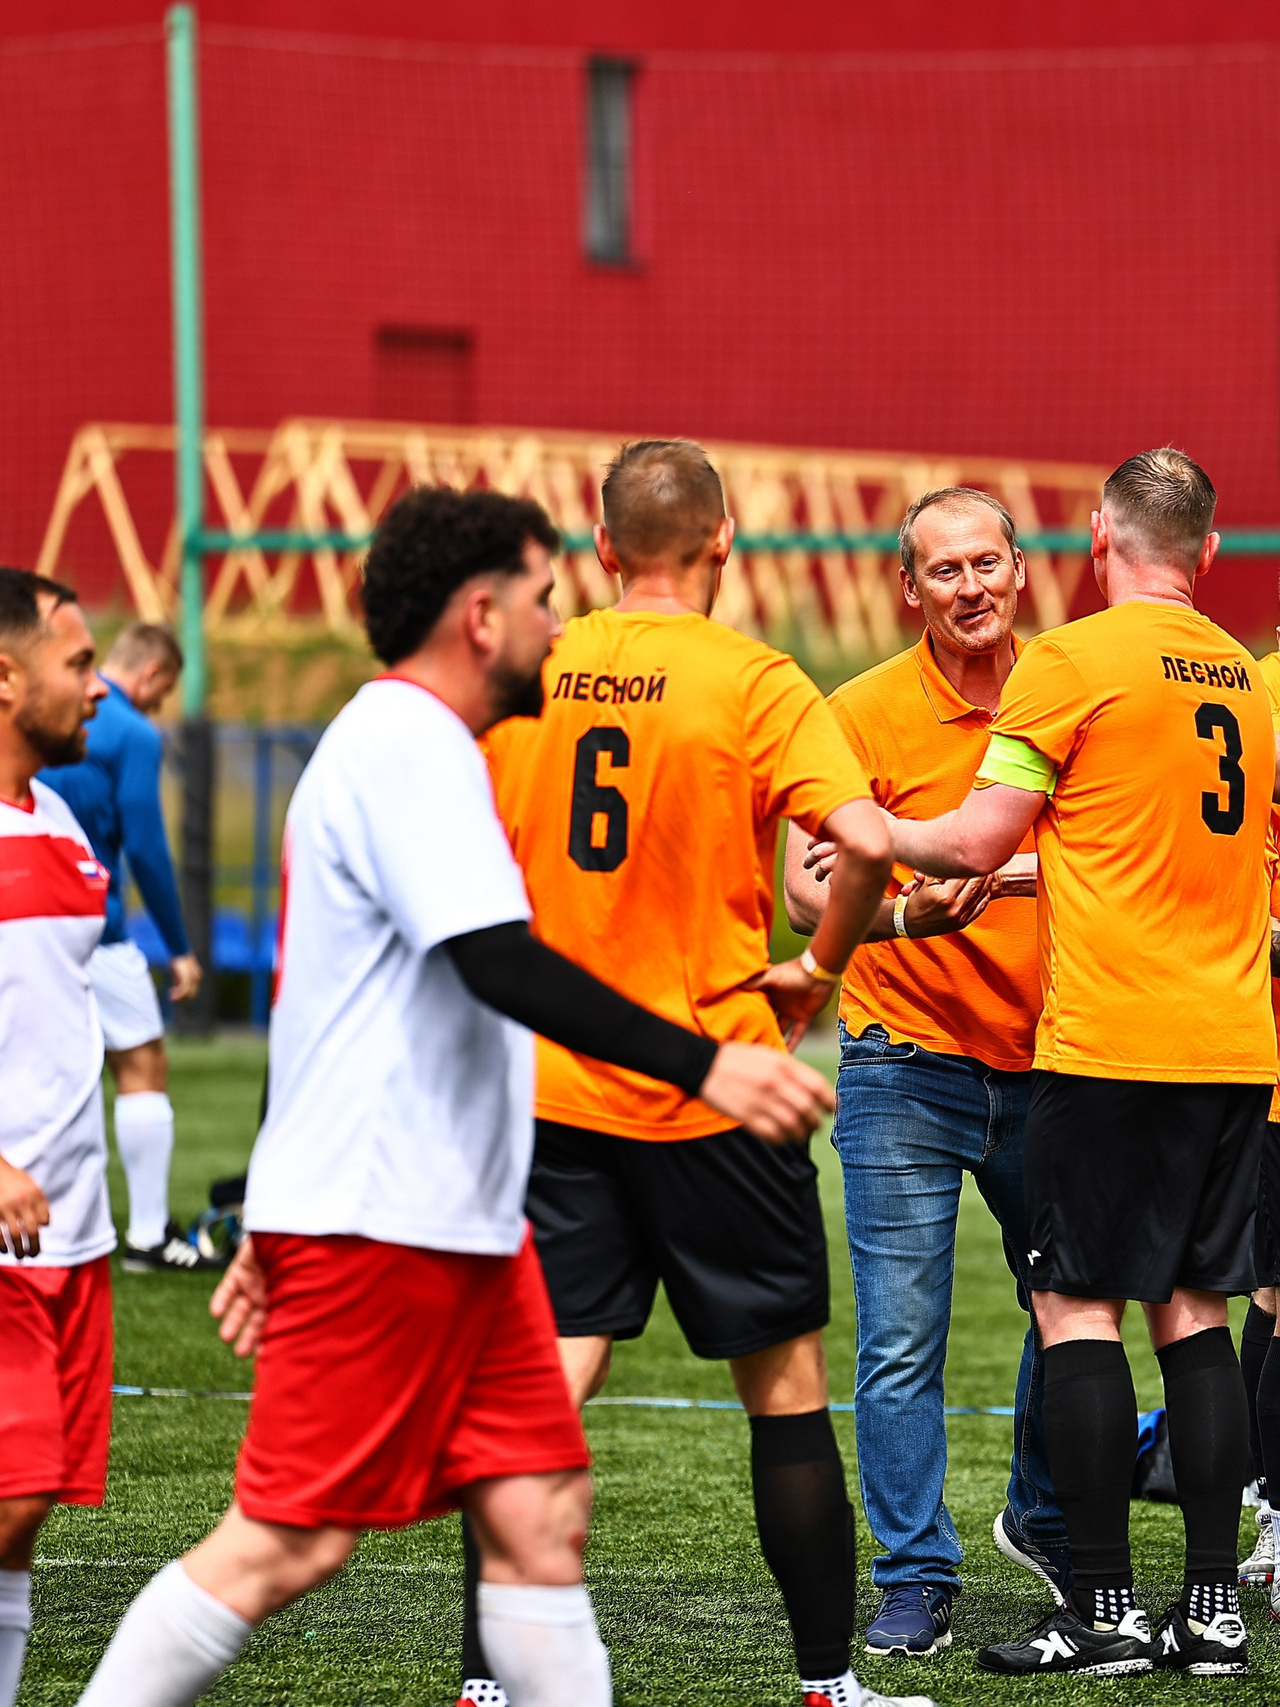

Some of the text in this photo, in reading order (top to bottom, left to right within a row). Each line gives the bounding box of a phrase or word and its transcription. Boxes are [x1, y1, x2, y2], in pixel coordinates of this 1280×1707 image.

[553, 666, 667, 704] ЛЕСНОЙ
[1161, 655, 1252, 692] ЛЕСНОЙ
[568, 727, 631, 872] 6
[1194, 702, 1246, 836] 3
